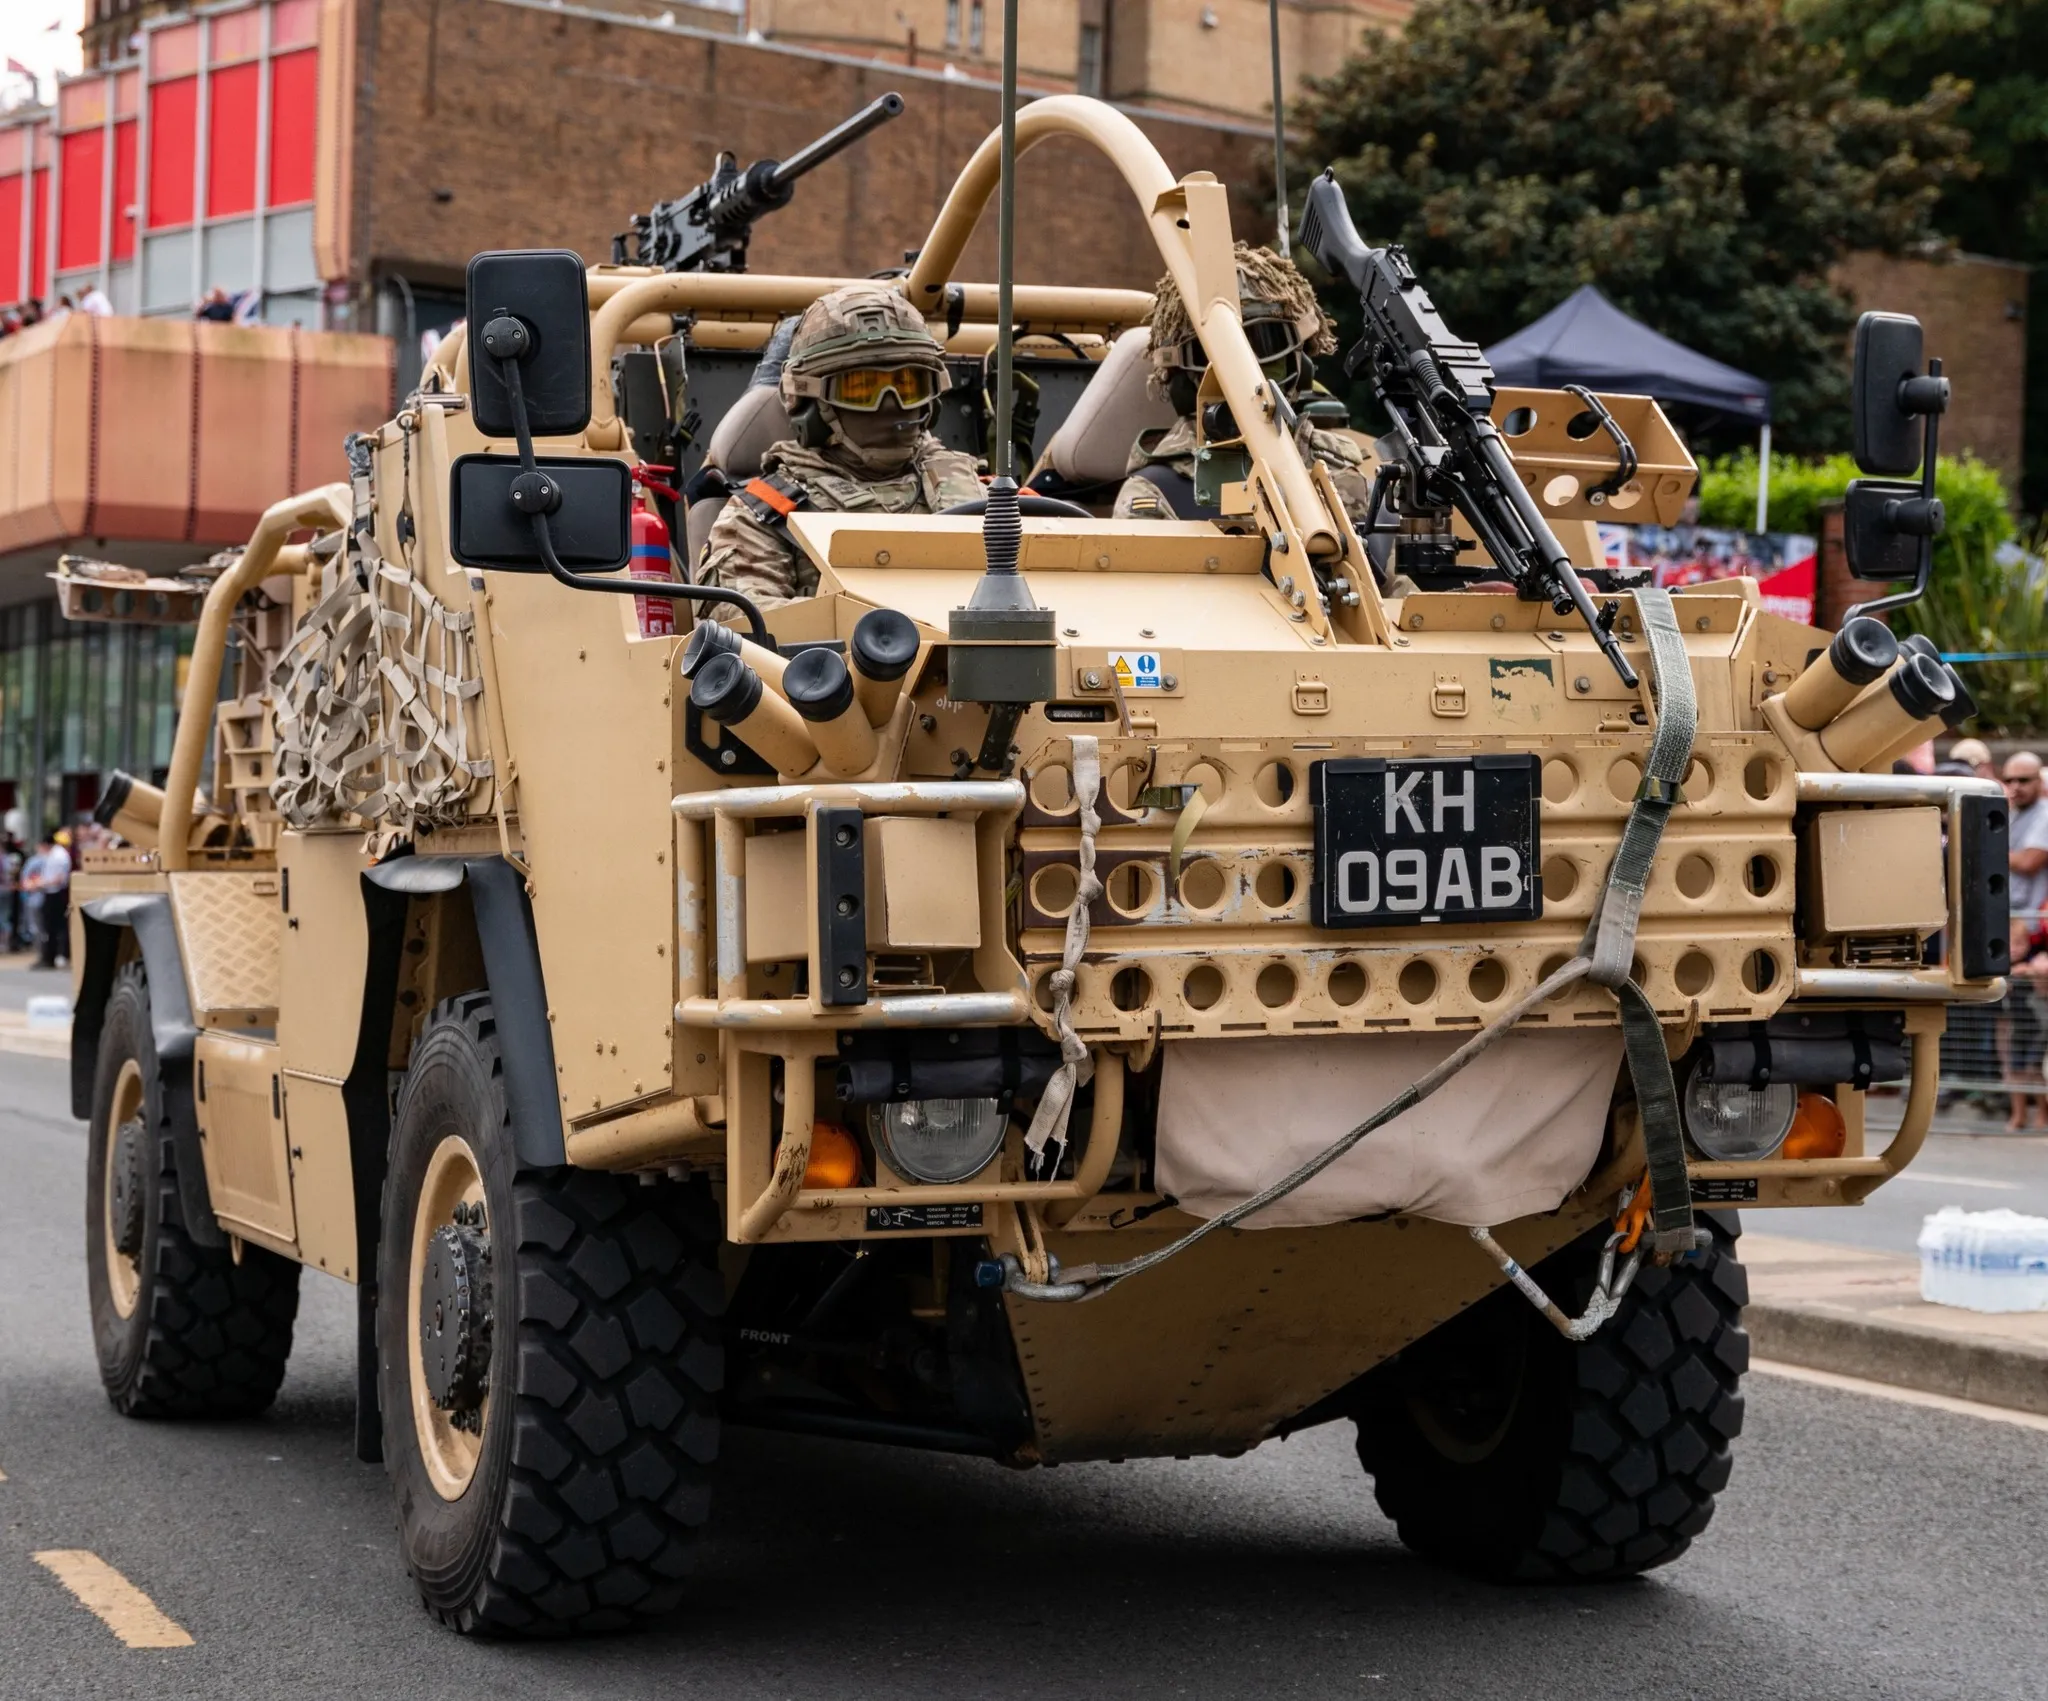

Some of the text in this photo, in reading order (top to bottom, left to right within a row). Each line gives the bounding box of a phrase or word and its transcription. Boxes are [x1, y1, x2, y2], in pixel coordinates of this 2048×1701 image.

[1385, 770, 1475, 834] KH
[1338, 846, 1523, 913] 09AB
[740, 1327, 792, 1345] FRONT
